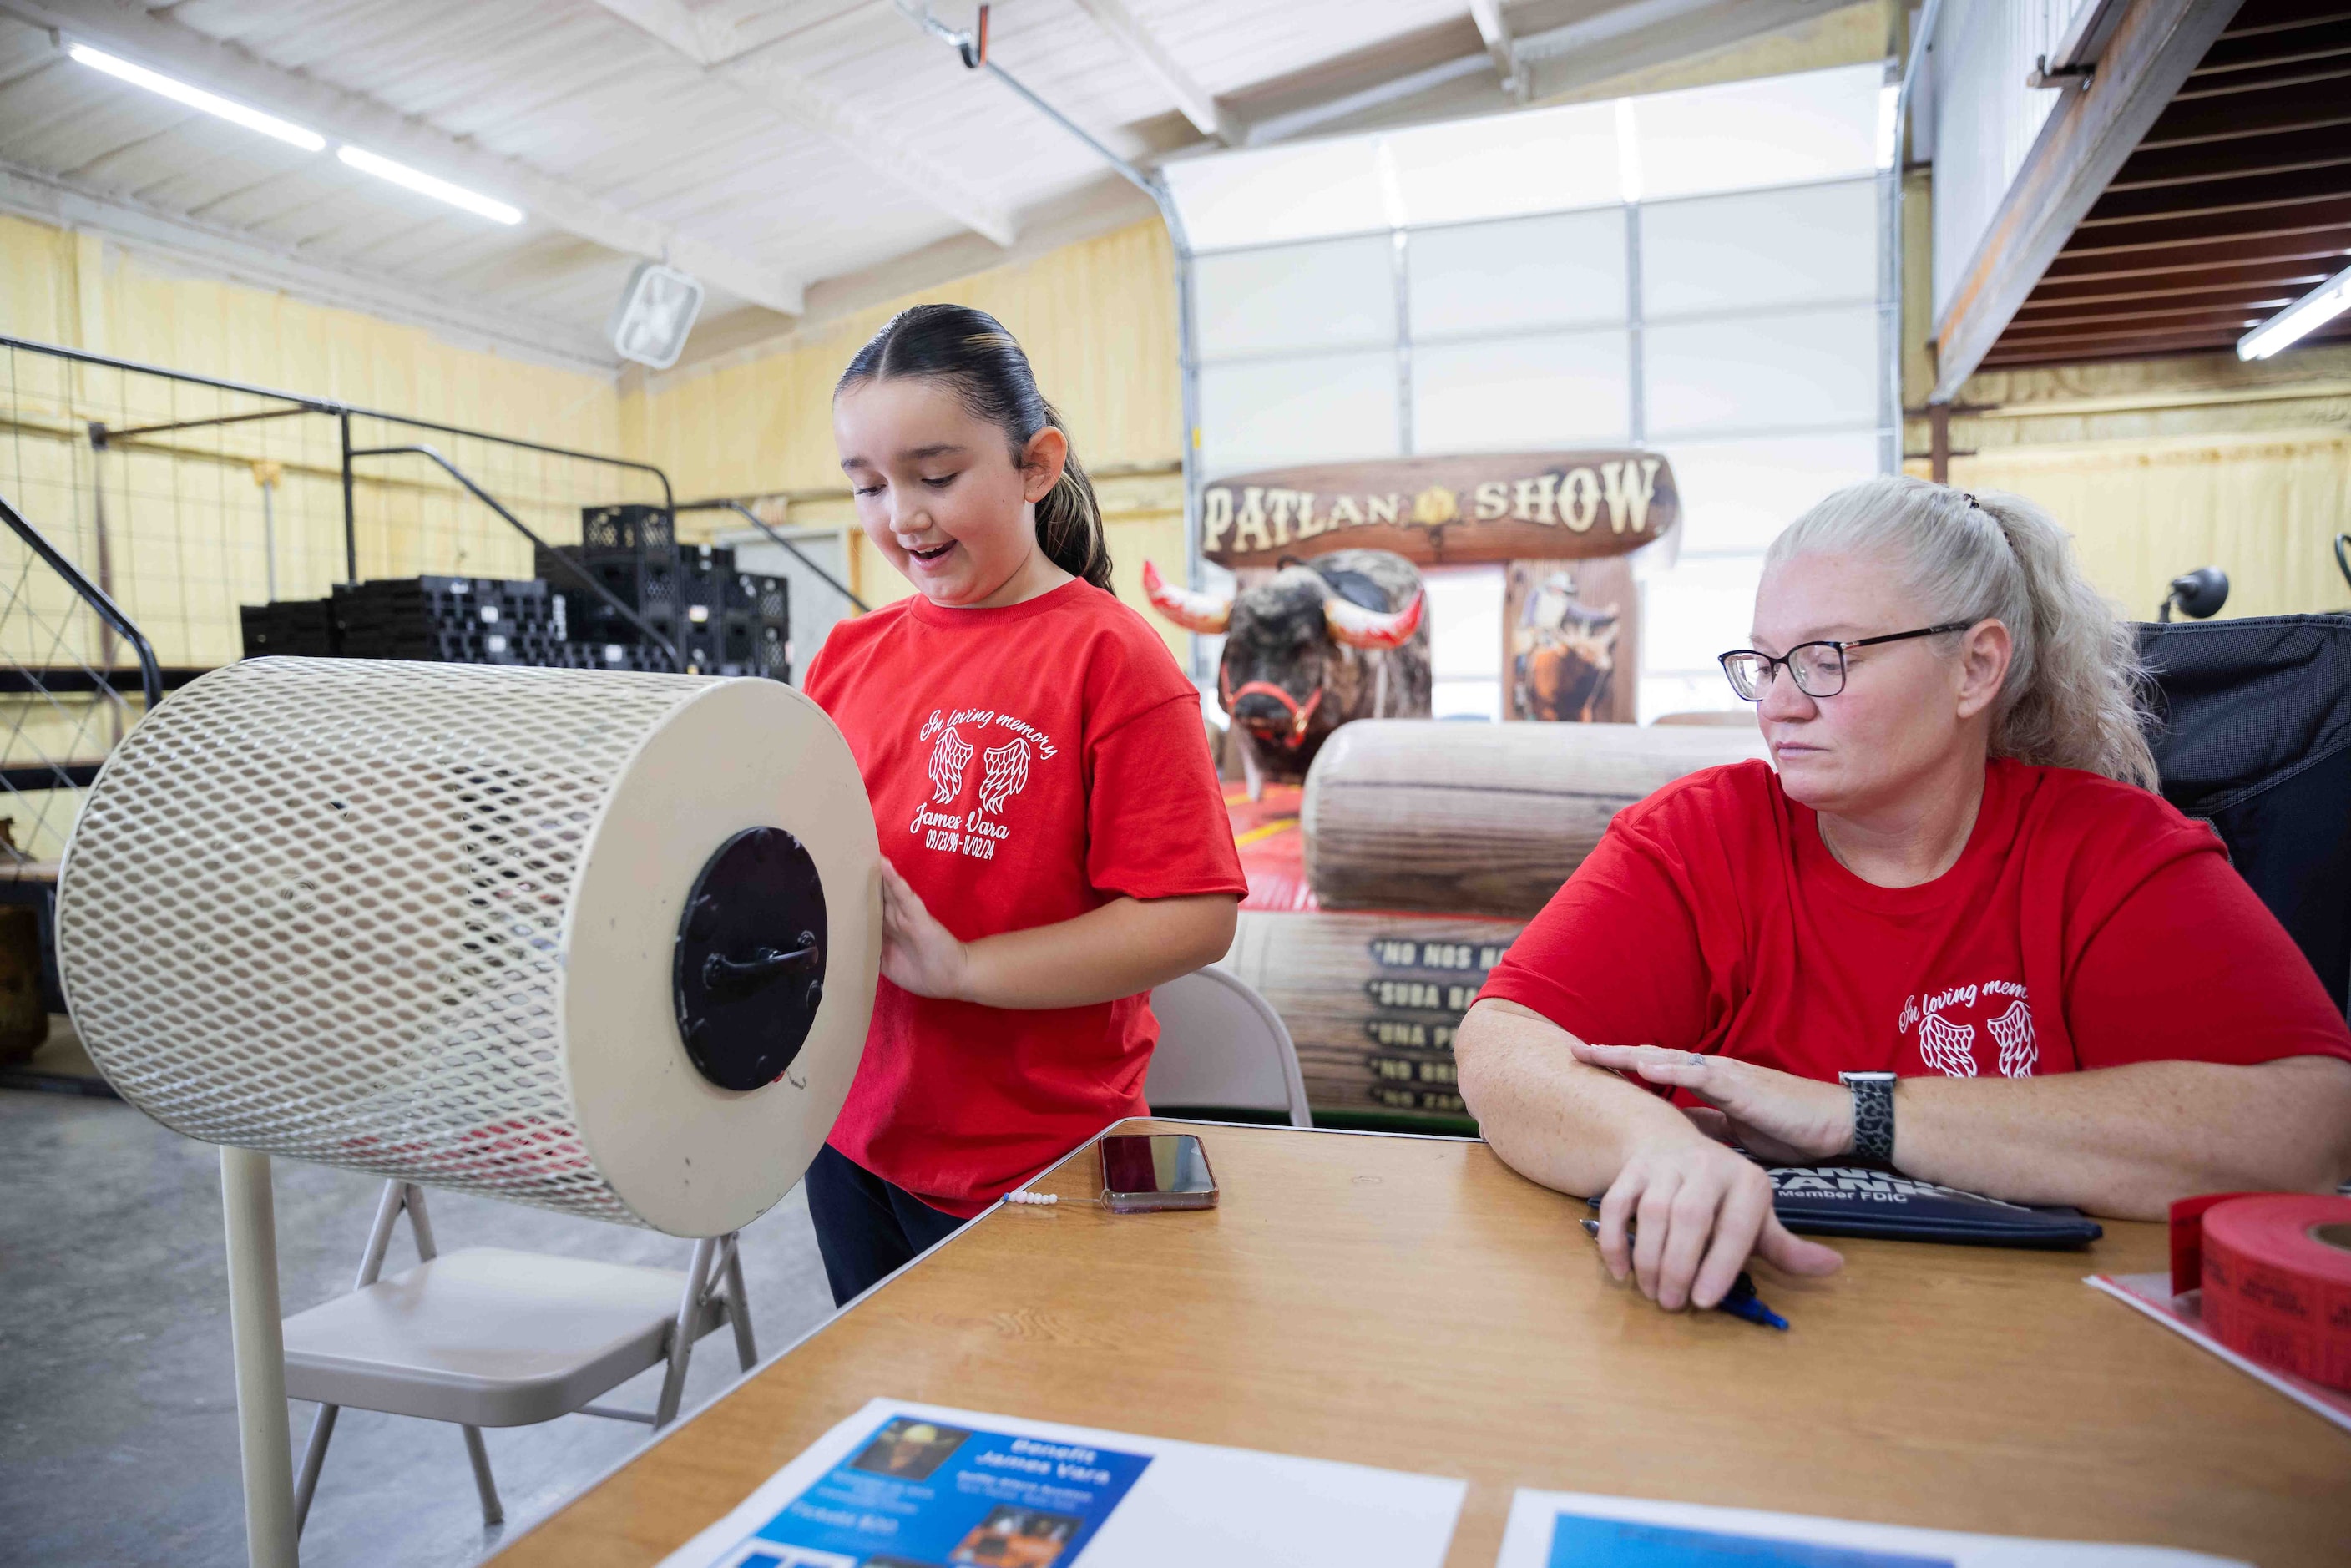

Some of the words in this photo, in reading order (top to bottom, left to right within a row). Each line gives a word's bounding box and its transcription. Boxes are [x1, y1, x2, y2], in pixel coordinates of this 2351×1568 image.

[1203, 487, 1399, 553] PATLAN
[1474, 458, 1661, 534] SHOW
[919, 709, 943, 741] In
[946, 707, 995, 729] loving
[995, 712, 1059, 761] memory
[909, 802, 962, 834] James
[965, 807, 1010, 840] Vara
[1898, 994, 1920, 1034] In
[1922, 984, 1977, 1016] loving
[1981, 979, 2029, 999] mem
[1778, 1190, 1856, 1201] Member
[1860, 1191, 1909, 1204] FDIC
[974, 1450, 1052, 1475] James
[1056, 1463, 1111, 1486] Vara
[1010, 1439, 1098, 1465] Benefit
